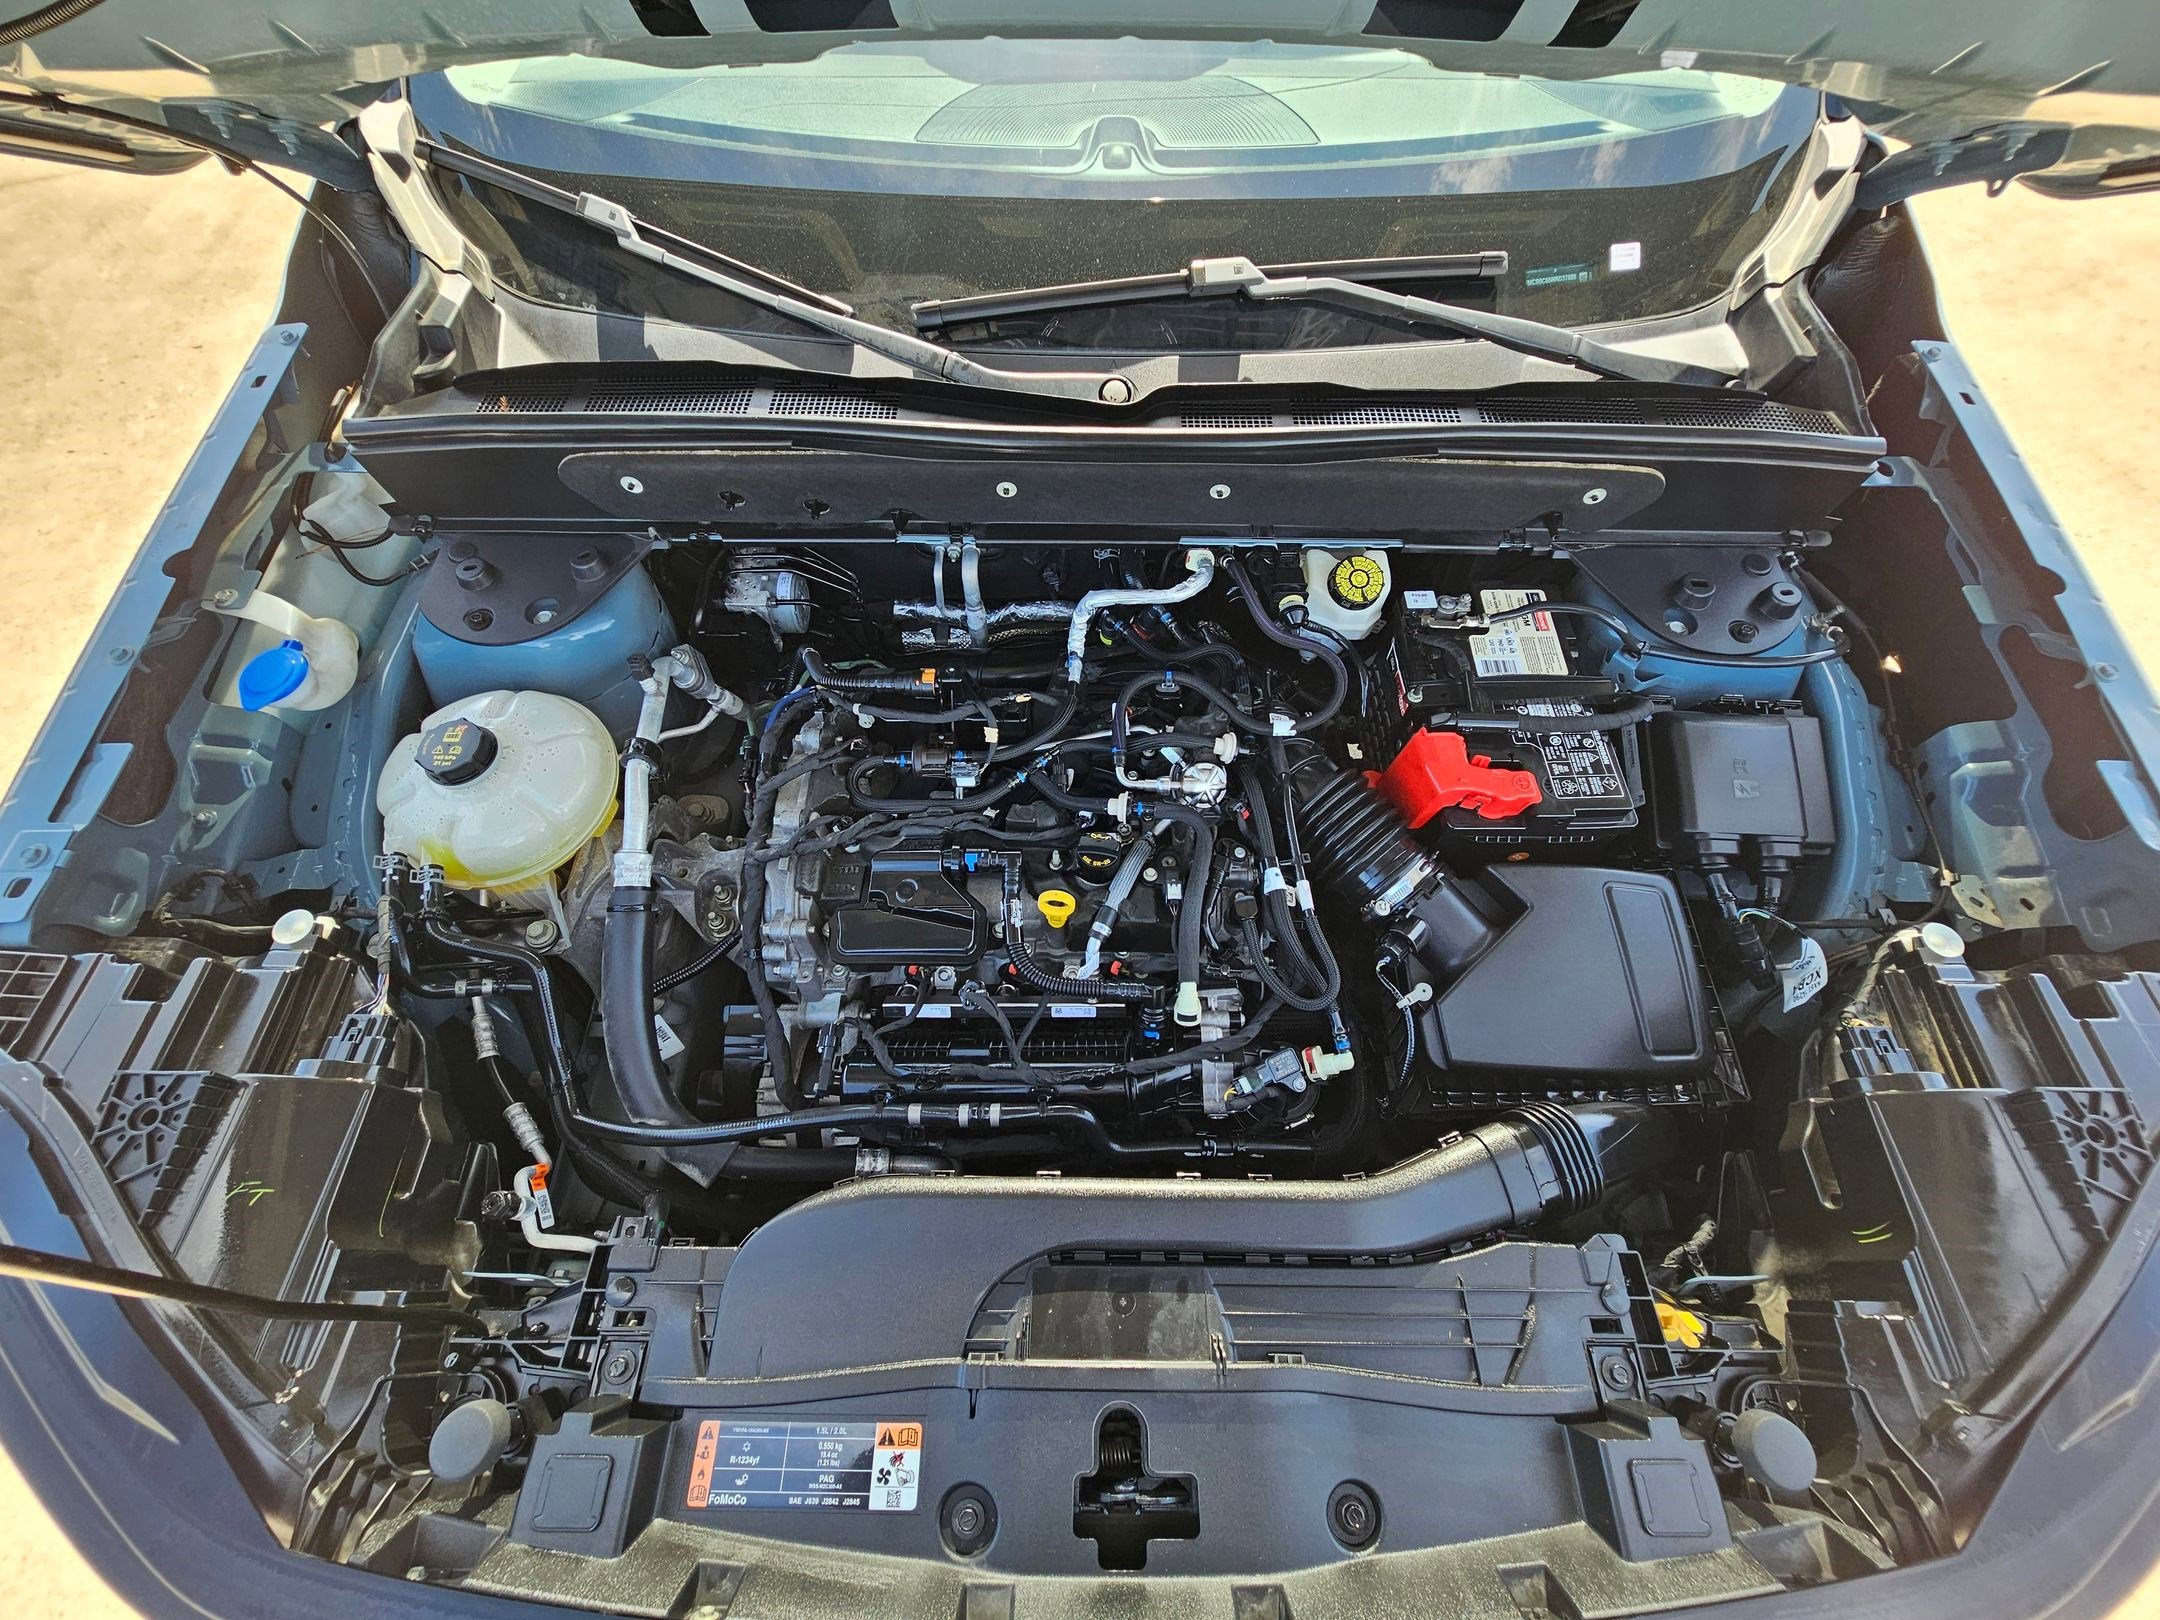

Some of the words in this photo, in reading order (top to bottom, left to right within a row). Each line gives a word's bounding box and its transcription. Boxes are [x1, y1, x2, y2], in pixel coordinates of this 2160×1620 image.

[834, 1427, 847, 1435] 2.0L
[818, 1441, 834, 1450] 0.550
[835, 1442, 843, 1452] kg
[730, 1455, 760, 1466] R-1234yf
[819, 1474, 835, 1483] PAG
[708, 1493, 747, 1505] FoMoCo
[788, 1496, 802, 1505] SAE
[821, 1498, 839, 1506] J2842
